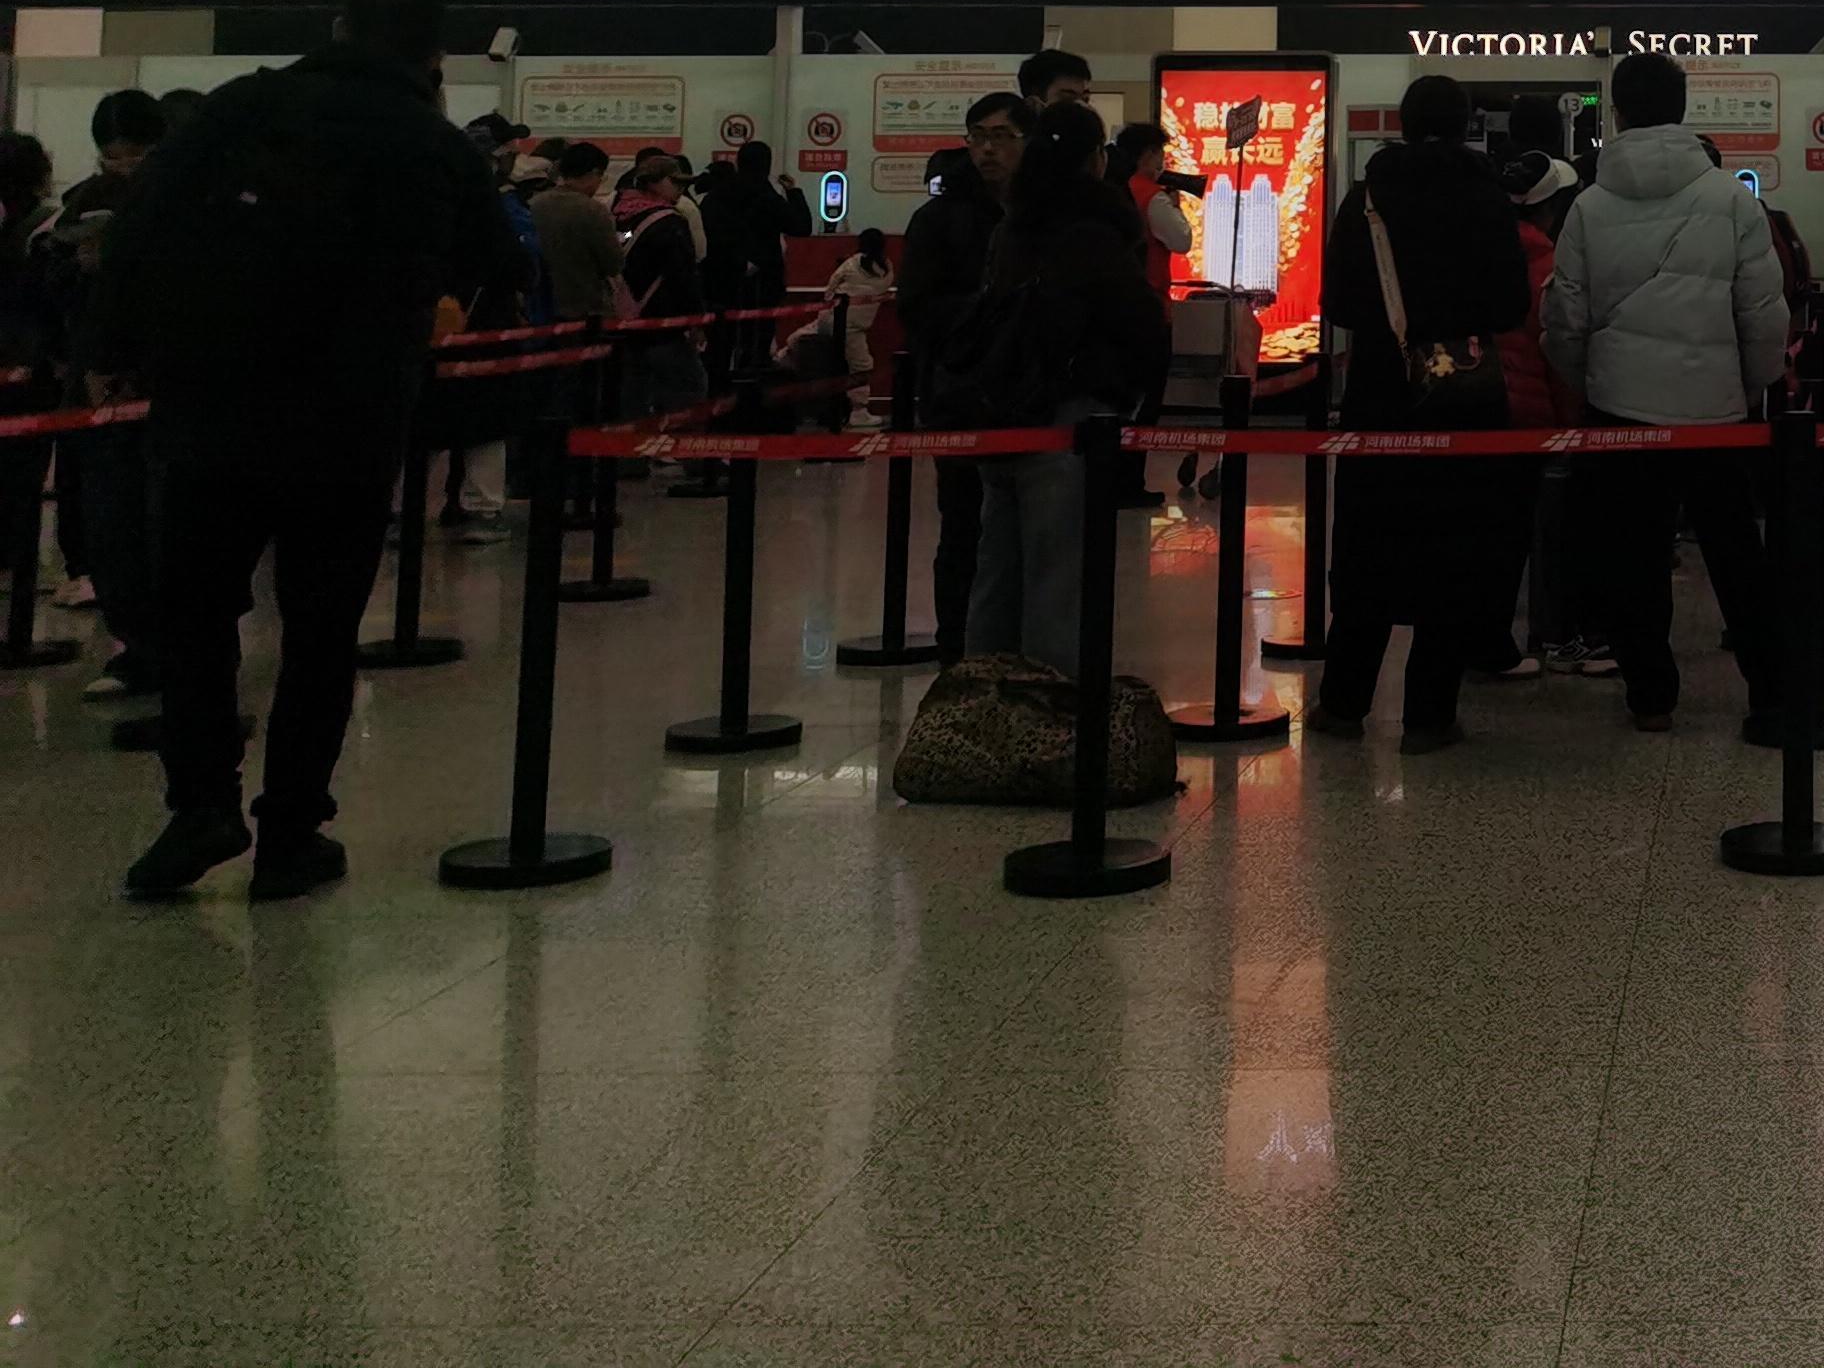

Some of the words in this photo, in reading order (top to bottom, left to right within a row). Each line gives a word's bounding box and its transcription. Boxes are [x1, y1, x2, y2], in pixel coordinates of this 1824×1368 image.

[1628, 30, 1759, 56] SECRET
[1564, 99, 1579, 111] 13
[1193, 101, 1297, 131] 稳富
[1587, 430, 1671, 444] 河南机场集团
